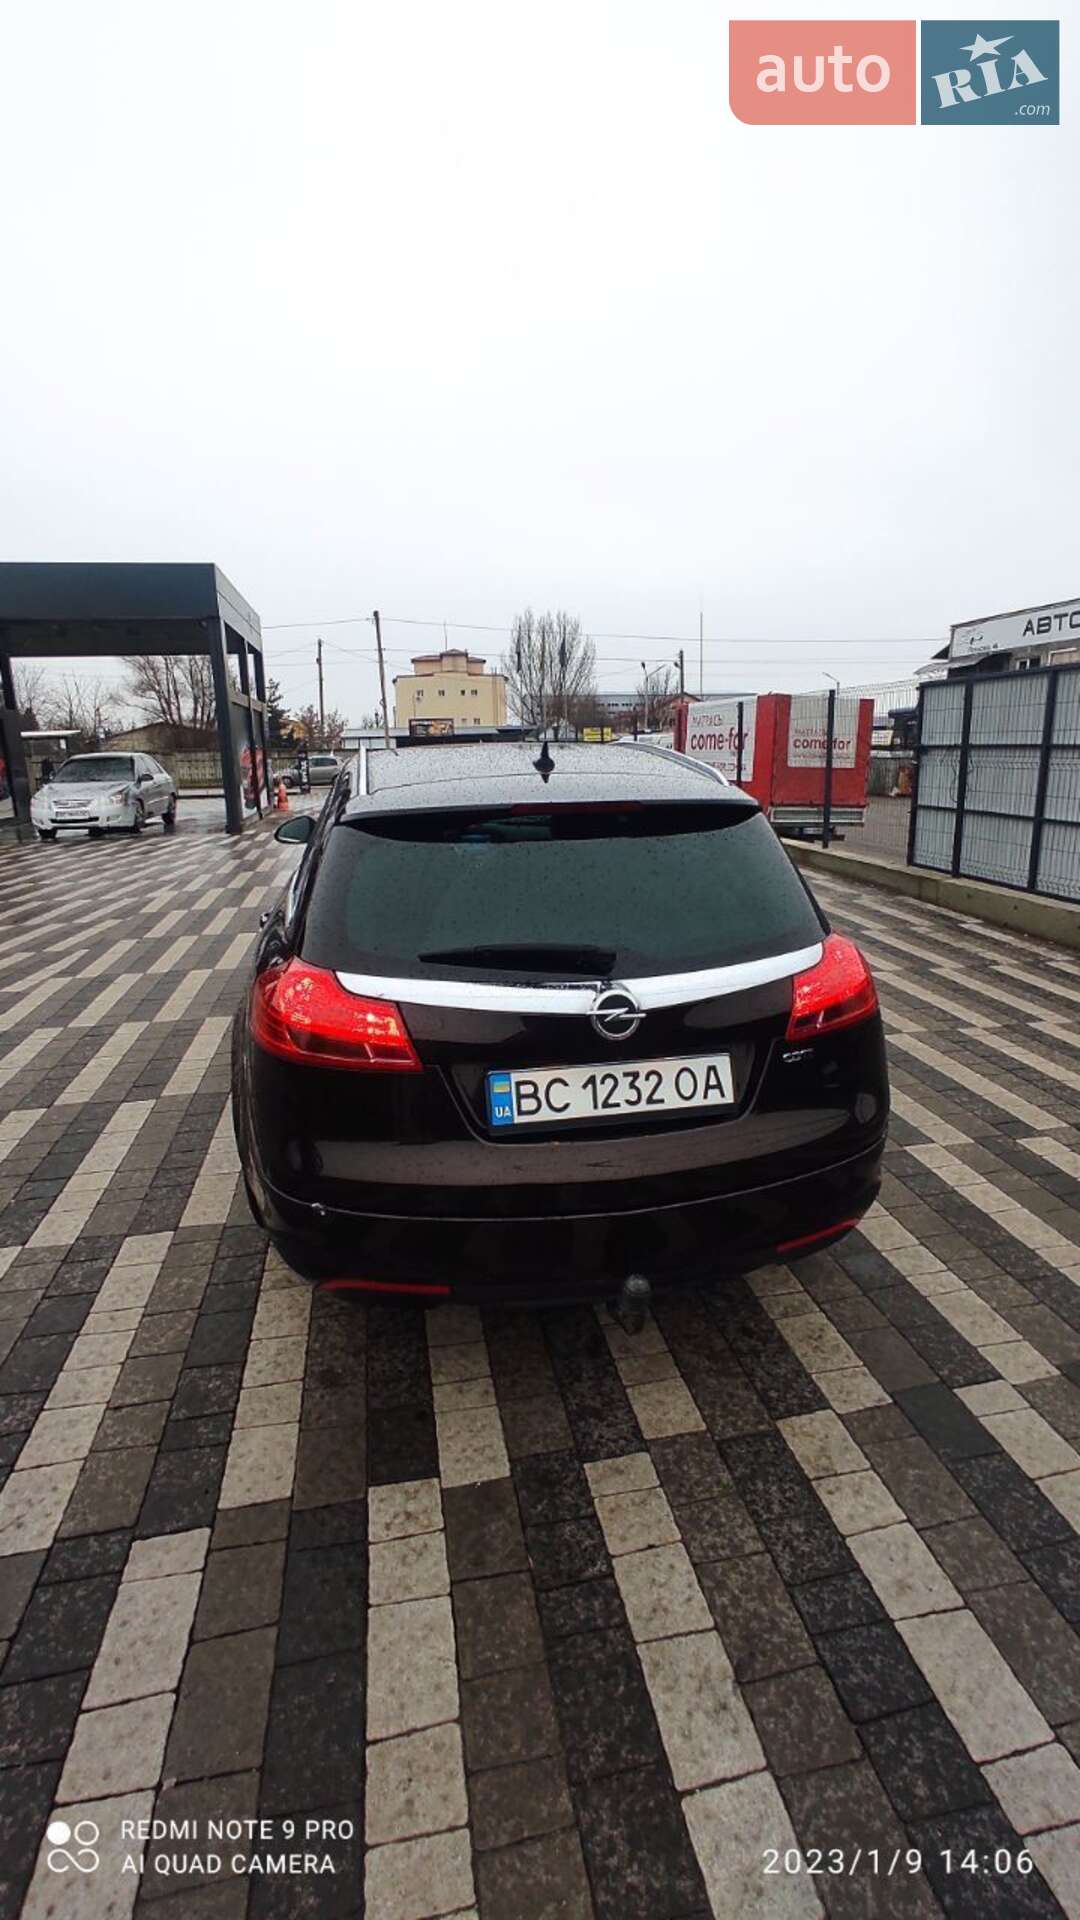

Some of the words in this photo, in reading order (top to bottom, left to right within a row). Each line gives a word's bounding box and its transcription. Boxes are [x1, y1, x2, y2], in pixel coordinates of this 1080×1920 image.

[793, 738, 851, 750] comefor
[515, 1077, 571, 1116] BC
[581, 1069, 665, 1110] 1232
[675, 1064, 726, 1101] OA
[495, 1106, 512, 1118] UA
